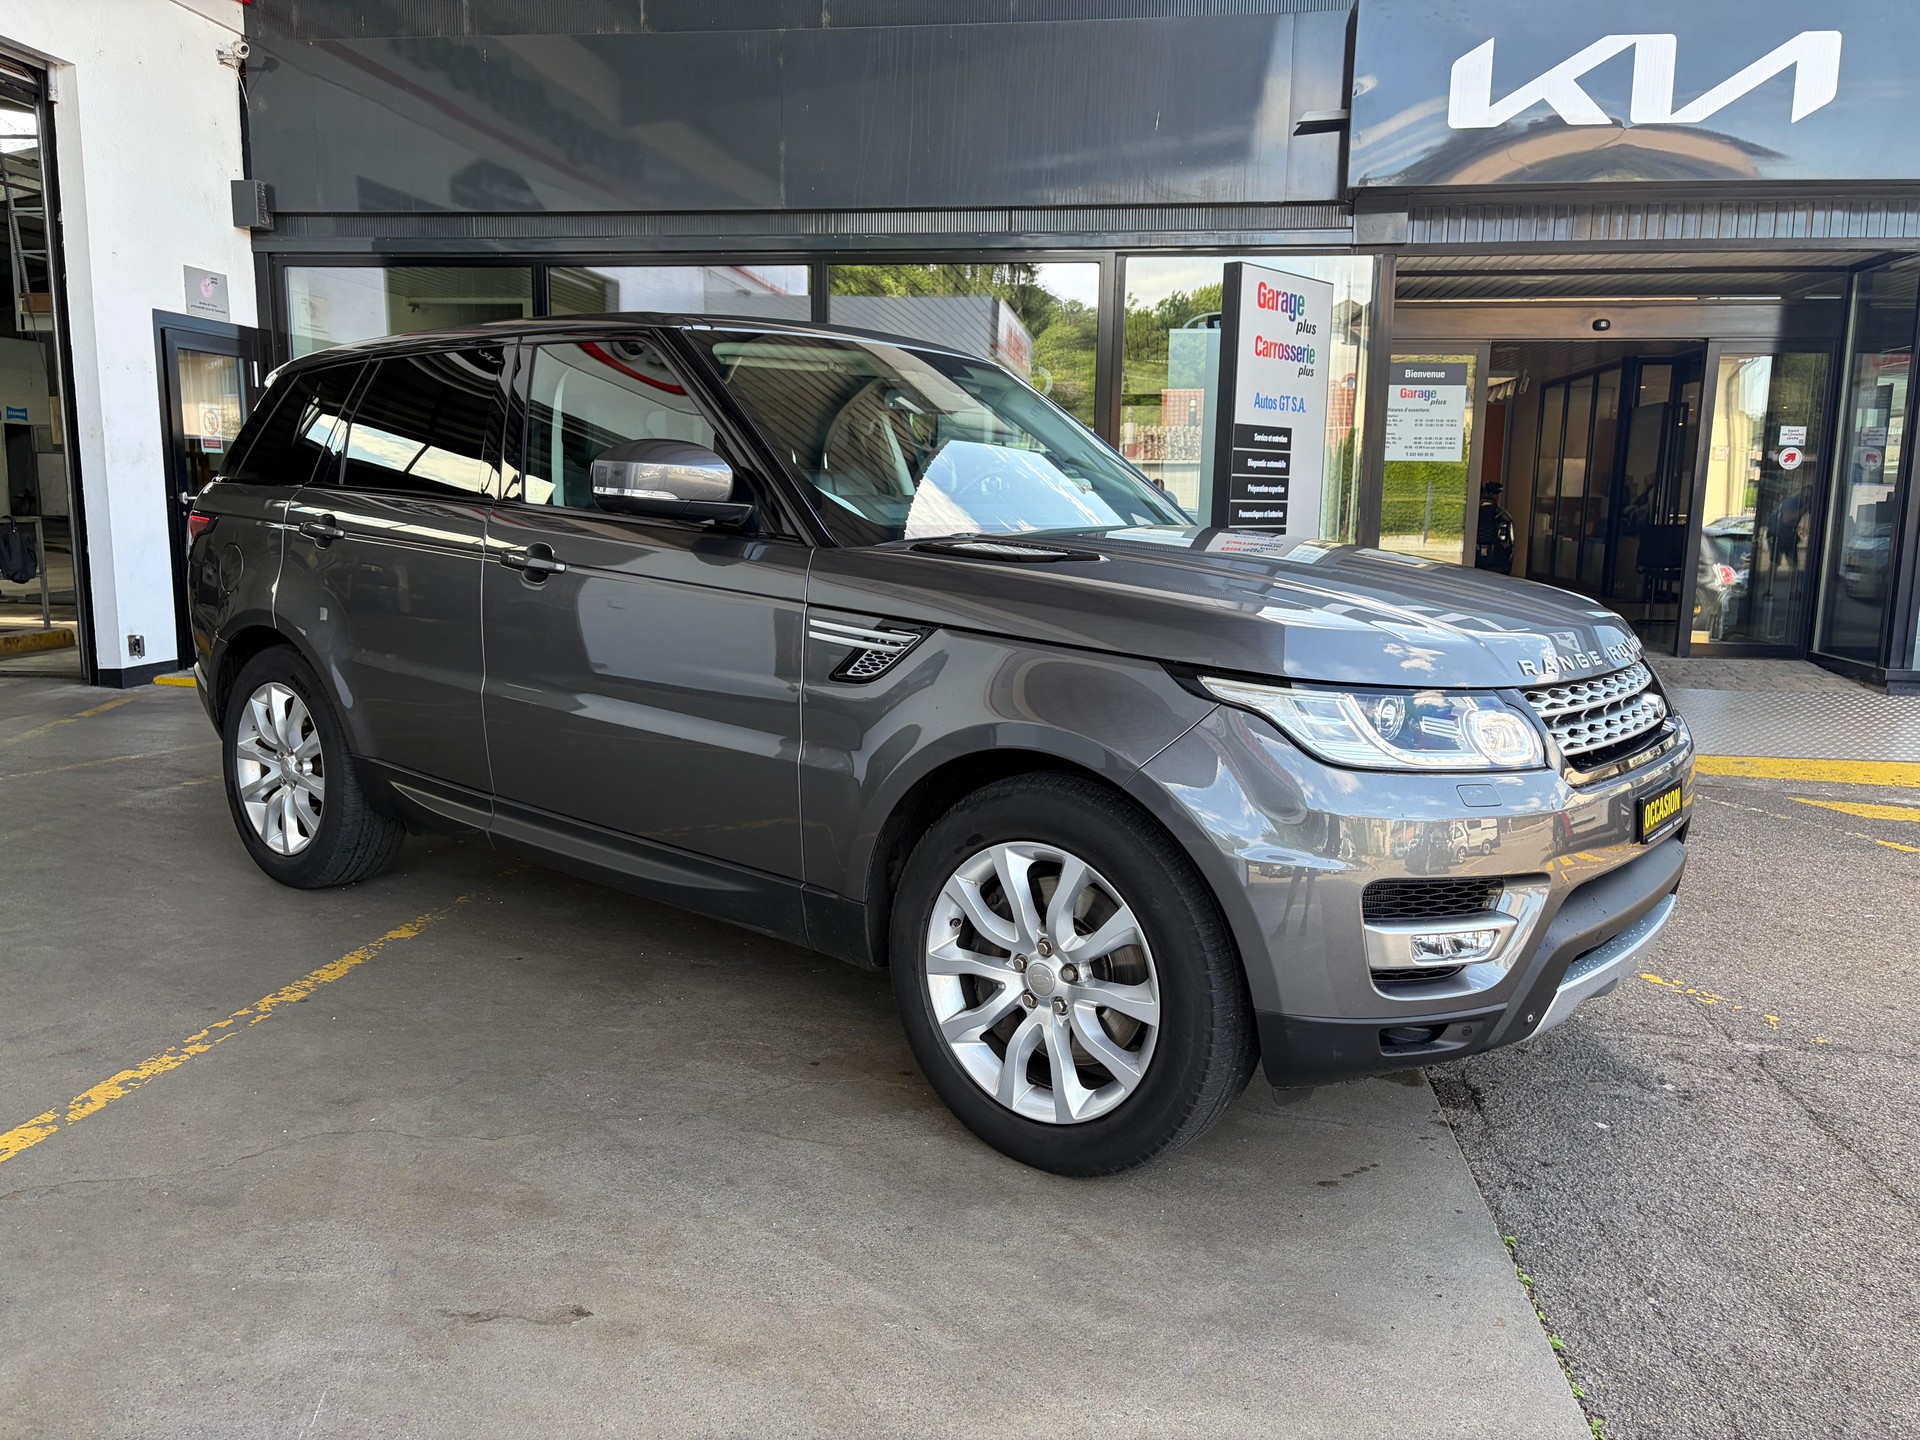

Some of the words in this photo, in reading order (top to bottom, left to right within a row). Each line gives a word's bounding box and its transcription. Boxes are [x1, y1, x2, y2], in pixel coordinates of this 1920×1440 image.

[1257, 281, 1305, 322] Garage
[1296, 319, 1317, 335] plus
[1255, 335, 1316, 365] Carrosserie
[1298, 365, 1315, 378] plus
[1405, 369, 1446, 379] Bienvenue
[1254, 392, 1277, 410] Autos
[1279, 395, 1290, 411] GT
[1400, 387, 1437, 402] Garage
[1518, 651, 1603, 676] RANGE
[1645, 787, 1680, 828] OCCASION
